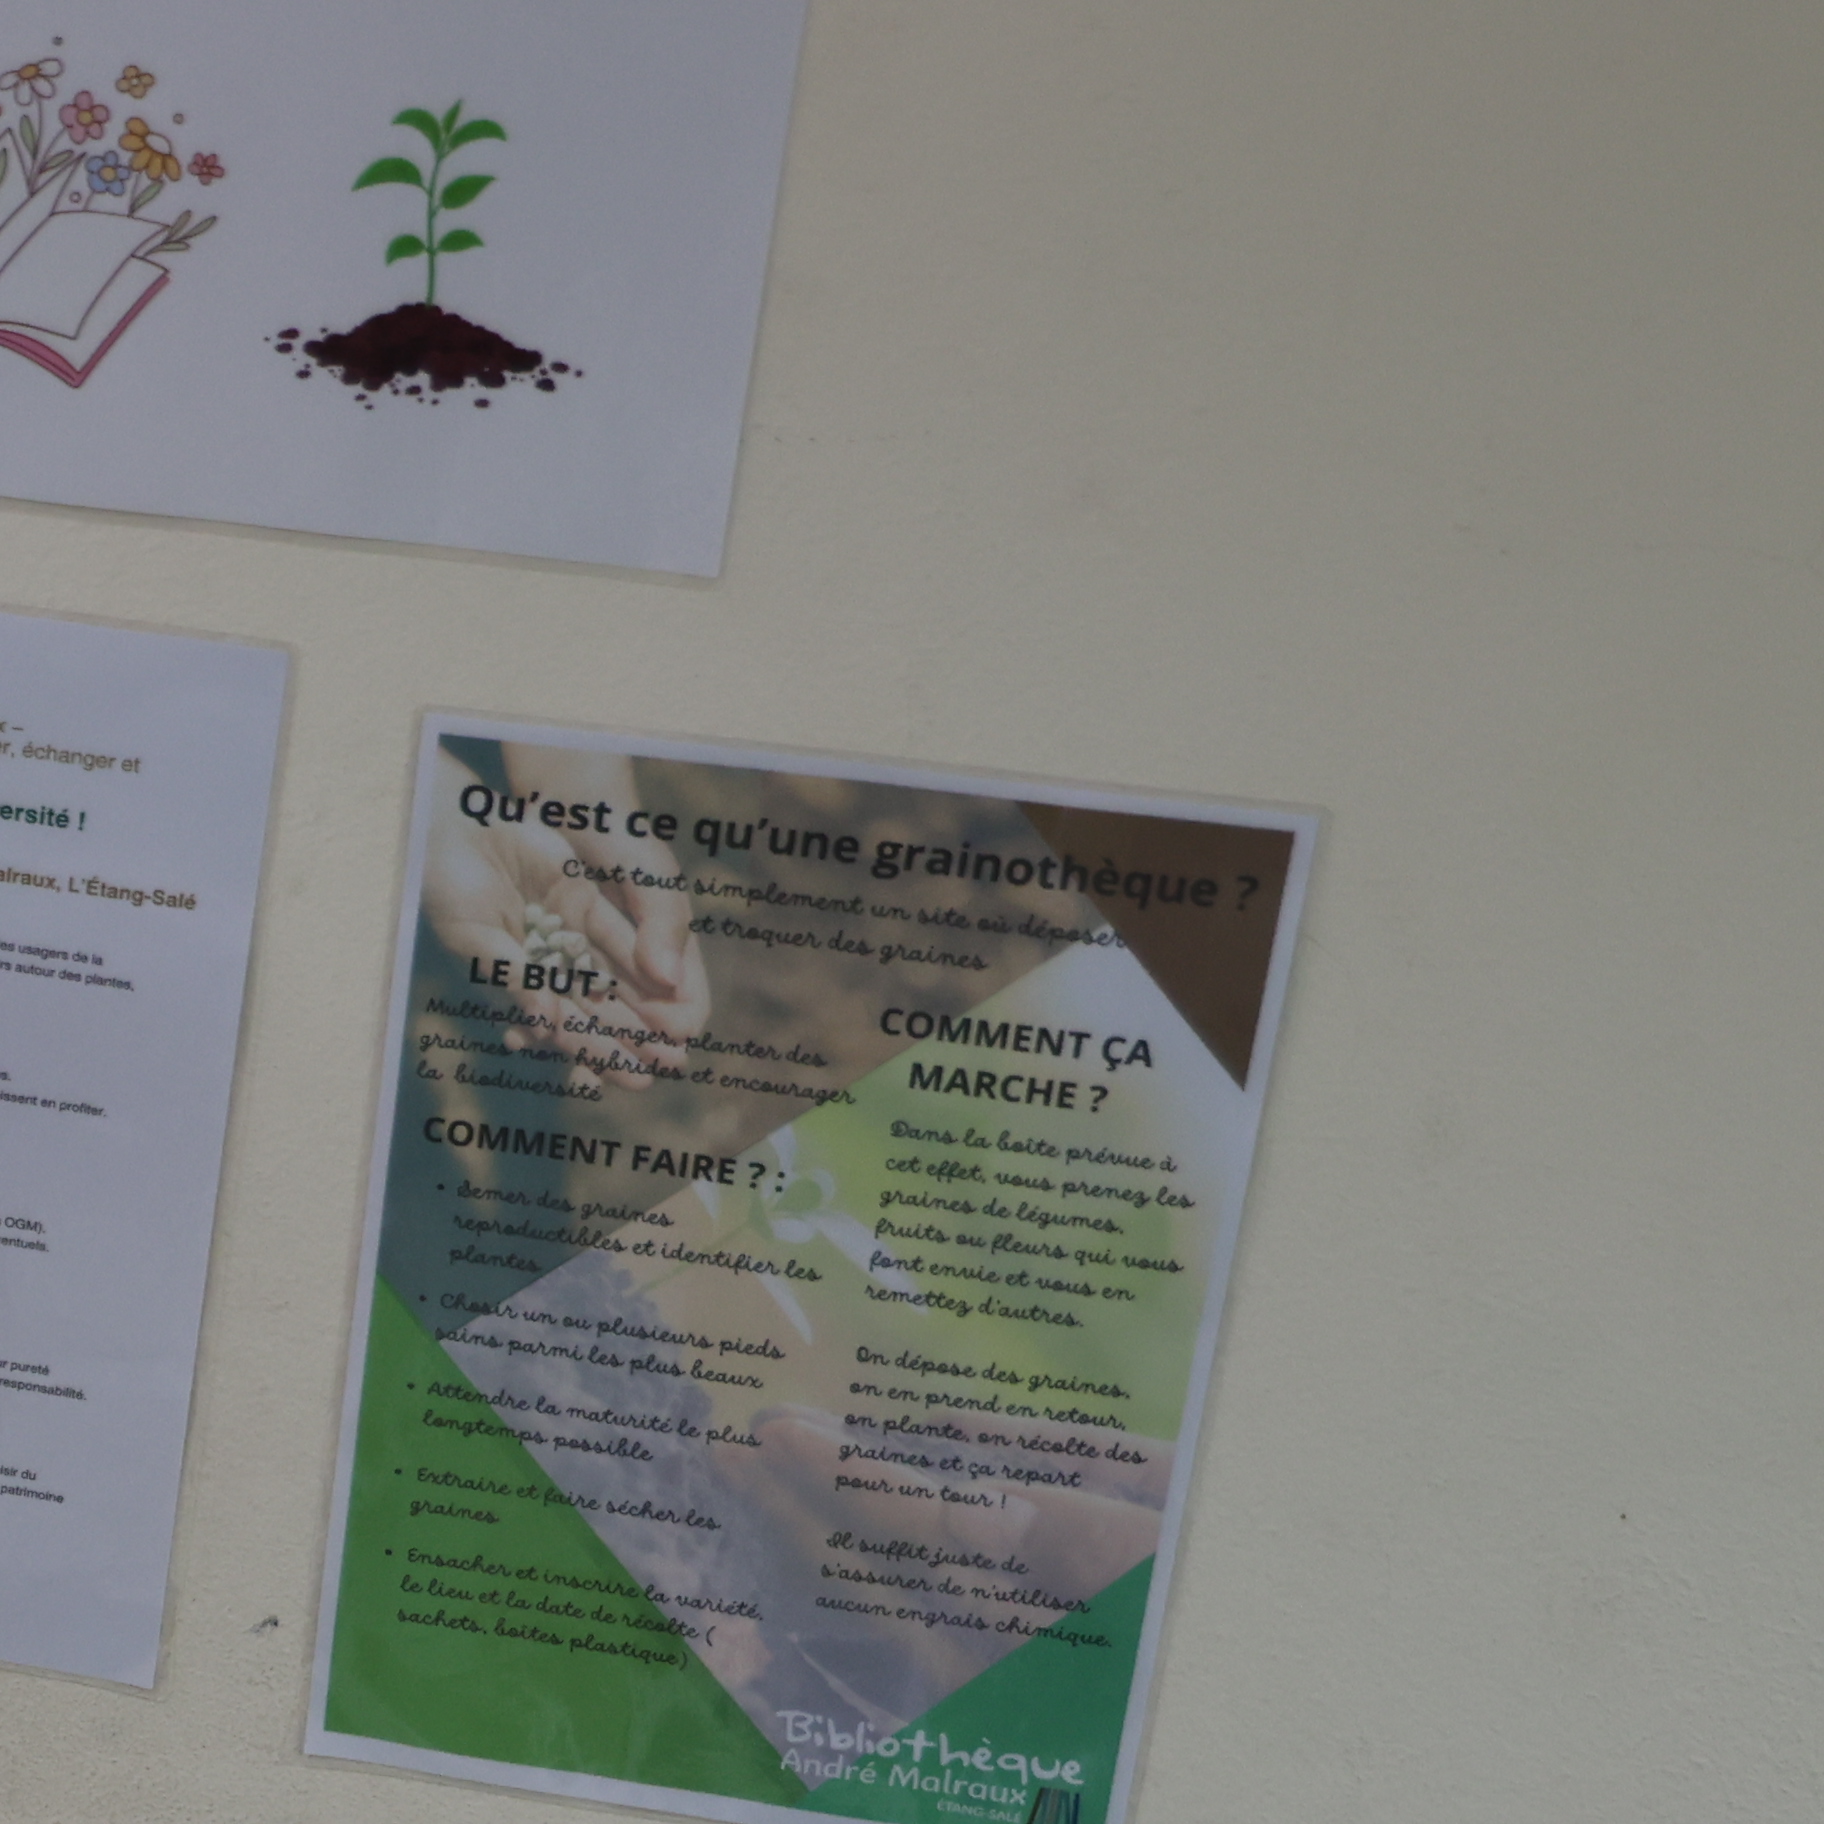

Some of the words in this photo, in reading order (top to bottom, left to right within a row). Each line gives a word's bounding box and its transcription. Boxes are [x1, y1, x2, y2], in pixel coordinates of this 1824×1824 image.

[21, 741, 117, 770] échanger
[121, 757, 142, 774] et
[78, 811, 86, 831] !
[459, 780, 612, 834] Qu'est
[626, 799, 679, 842] ce
[693, 818, 859, 864] qu'une
[870, 837, 1221, 908] grainothèque
[1237, 874, 1259, 911] ?
[68, 876, 197, 910] L'Étang-Salé
[469, 956, 510, 989] LE
[523, 963, 598, 997] BUT
[609, 980, 617, 1000] :
[880, 1005, 1092, 1059] COMMENT
[1102, 1036, 1153, 1070] ÇA
[909, 1062, 1077, 1110] MARCHE
[1089, 1085, 1109, 1113] ?
[423, 1117, 620, 1167] COMMENT
[631, 1145, 739, 1186] FAIRE
[748, 1162, 767, 1190] ?
[775, 1171, 786, 1193] :
[774, 1710, 1086, 1787] Bibliothèque
[780, 1747, 877, 1784] André
[888, 1764, 1027, 1806] Malraux
